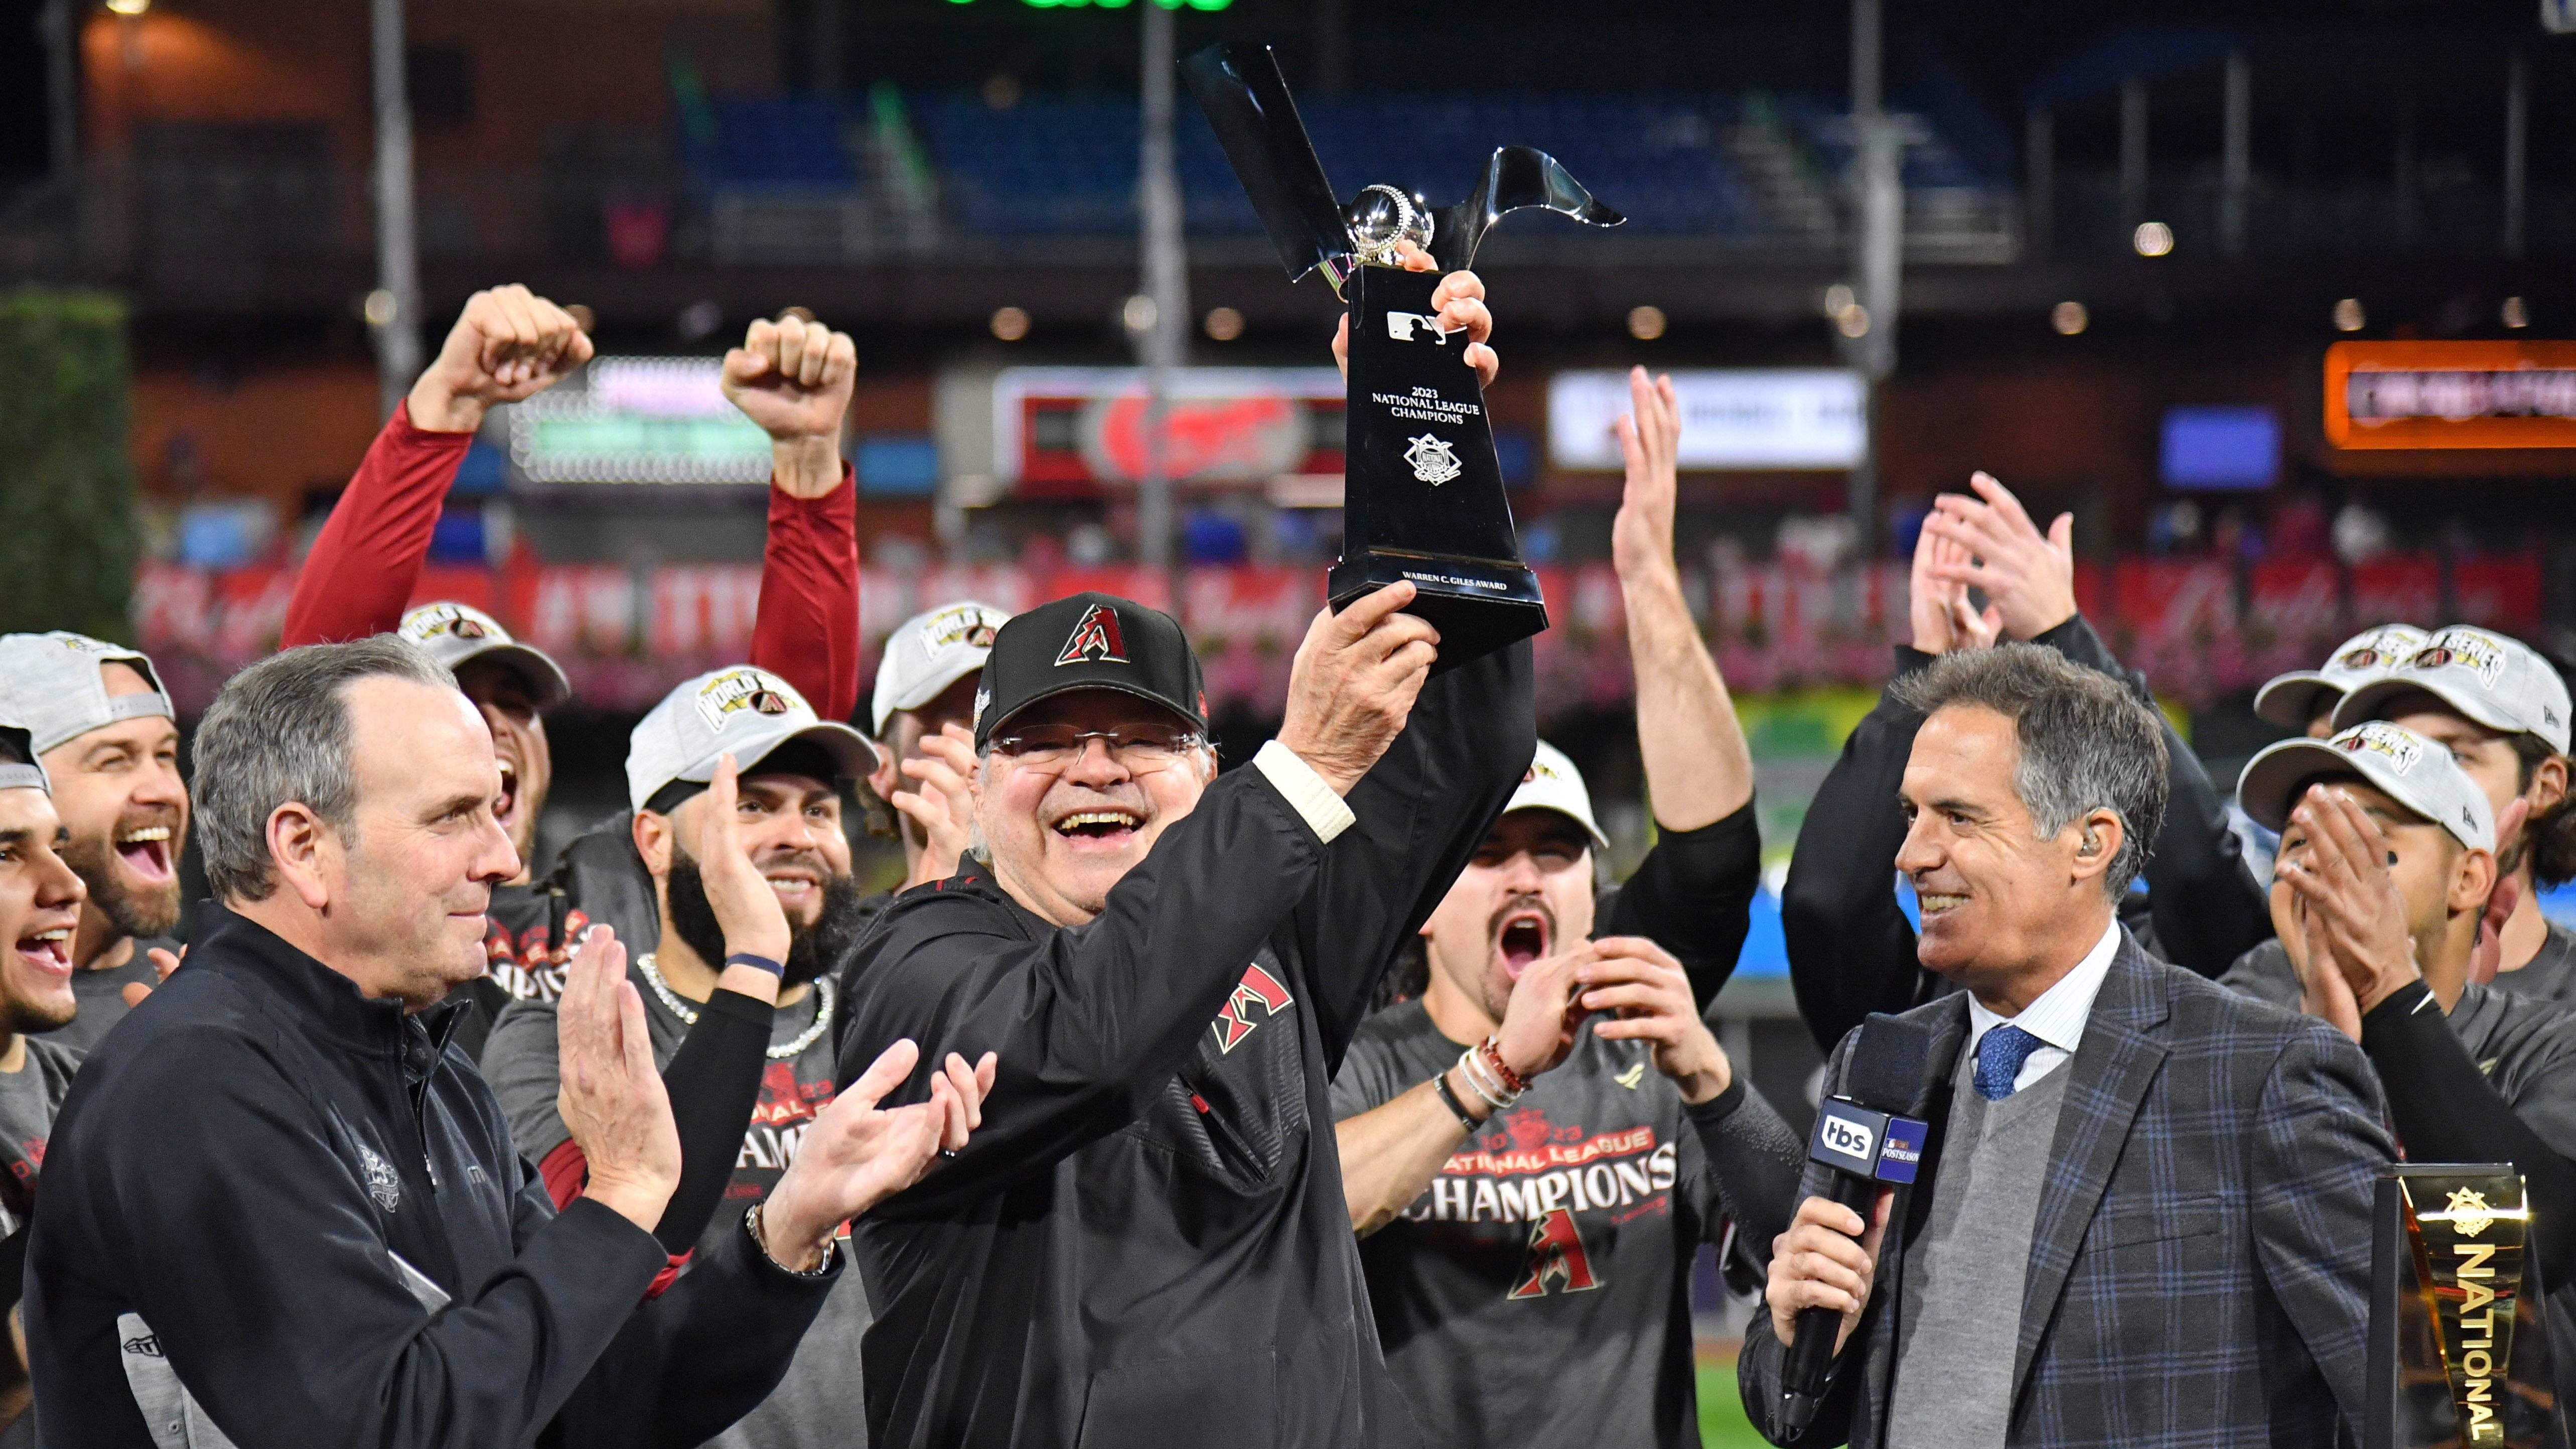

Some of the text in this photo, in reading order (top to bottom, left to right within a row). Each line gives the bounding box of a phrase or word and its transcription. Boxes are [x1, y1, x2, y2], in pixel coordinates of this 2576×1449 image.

[1372, 392, 1480, 415] NATIONAL LEAGUE
[1412, 386, 1439, 399] 2023
[1391, 407, 1464, 425] CHAMPIONS
[1402, 571, 1507, 591] WARREN C. GILES AWARD
[2444, 629, 2507, 688] SERIES
[697, 670, 759, 731] WORLD
[1442, 1127, 1651, 1174] ATINAL LEAGUE
[1827, 1121, 1866, 1152] tbs
[1401, 1141, 1677, 1224] CHAMPIONS
[2453, 1244, 2496, 1441] NATIONAL
